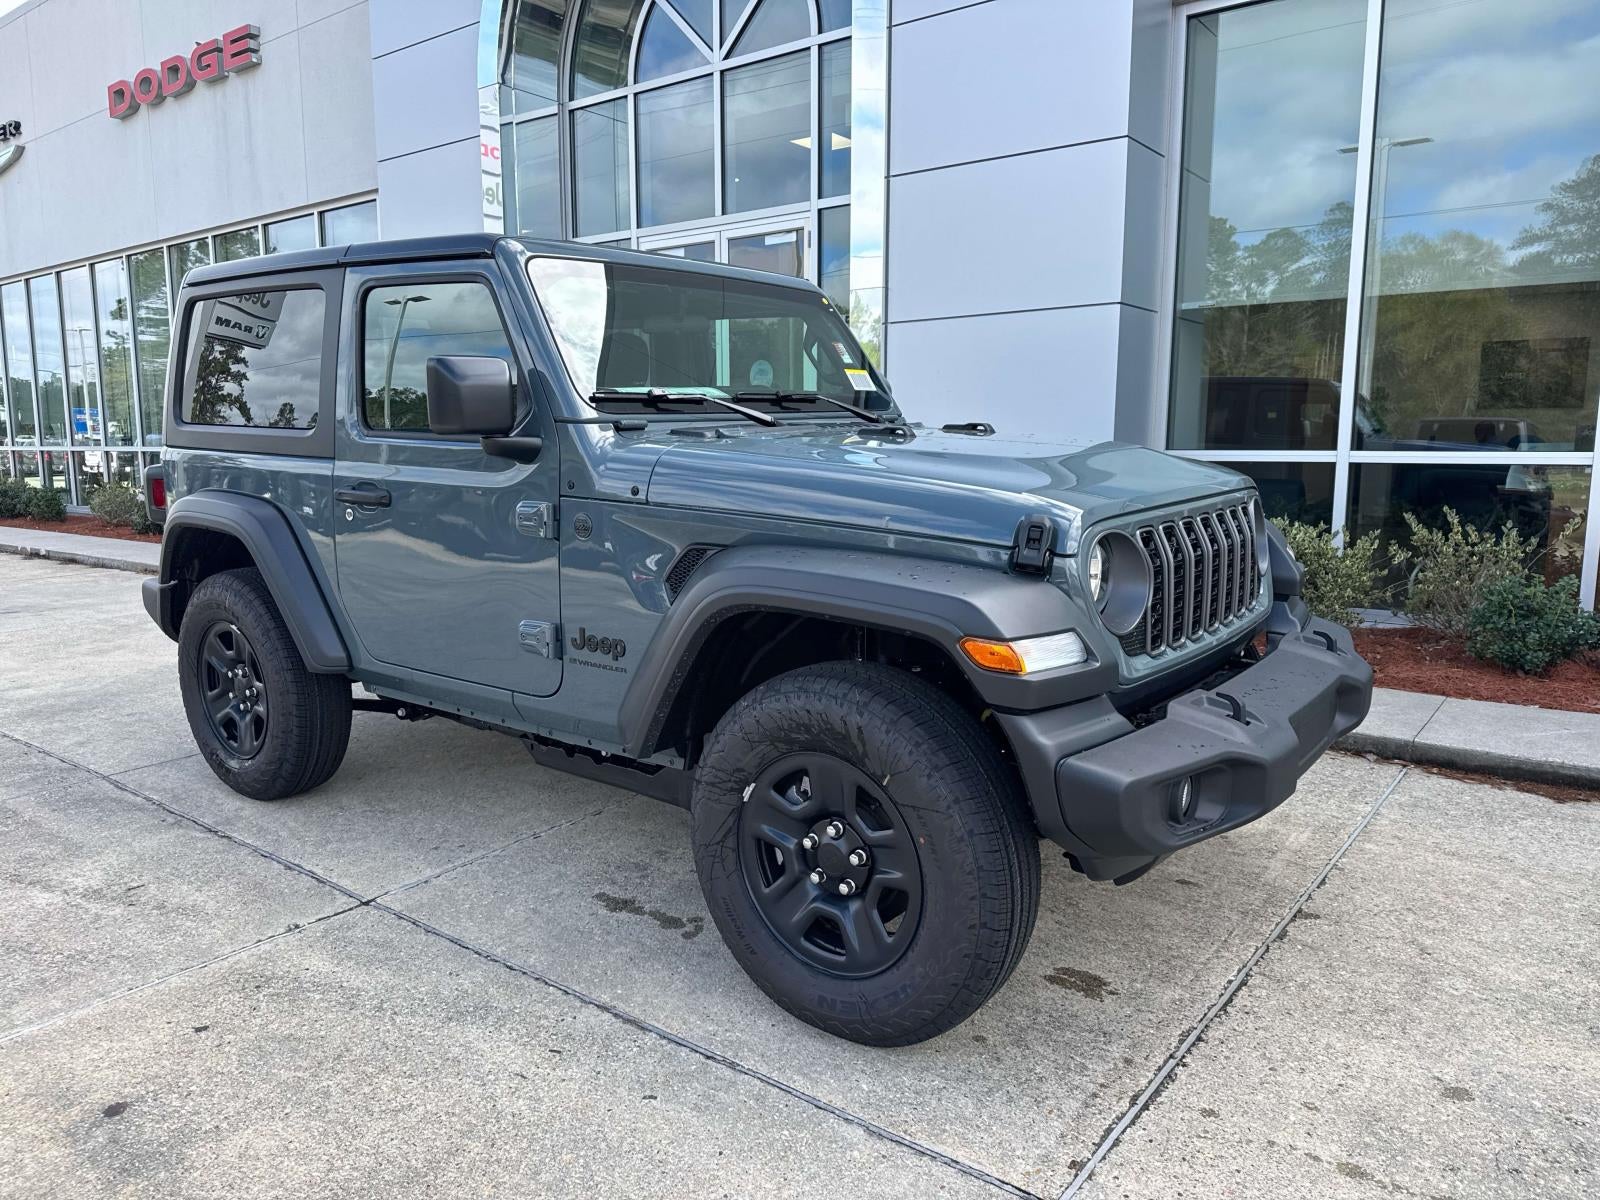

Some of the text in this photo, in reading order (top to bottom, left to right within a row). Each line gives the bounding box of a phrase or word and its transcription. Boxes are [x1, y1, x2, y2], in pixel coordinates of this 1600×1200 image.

[107, 24, 260, 119] DODGE
[571, 627, 626, 661] Jeep
[578, 659, 628, 674] WRANGLER
